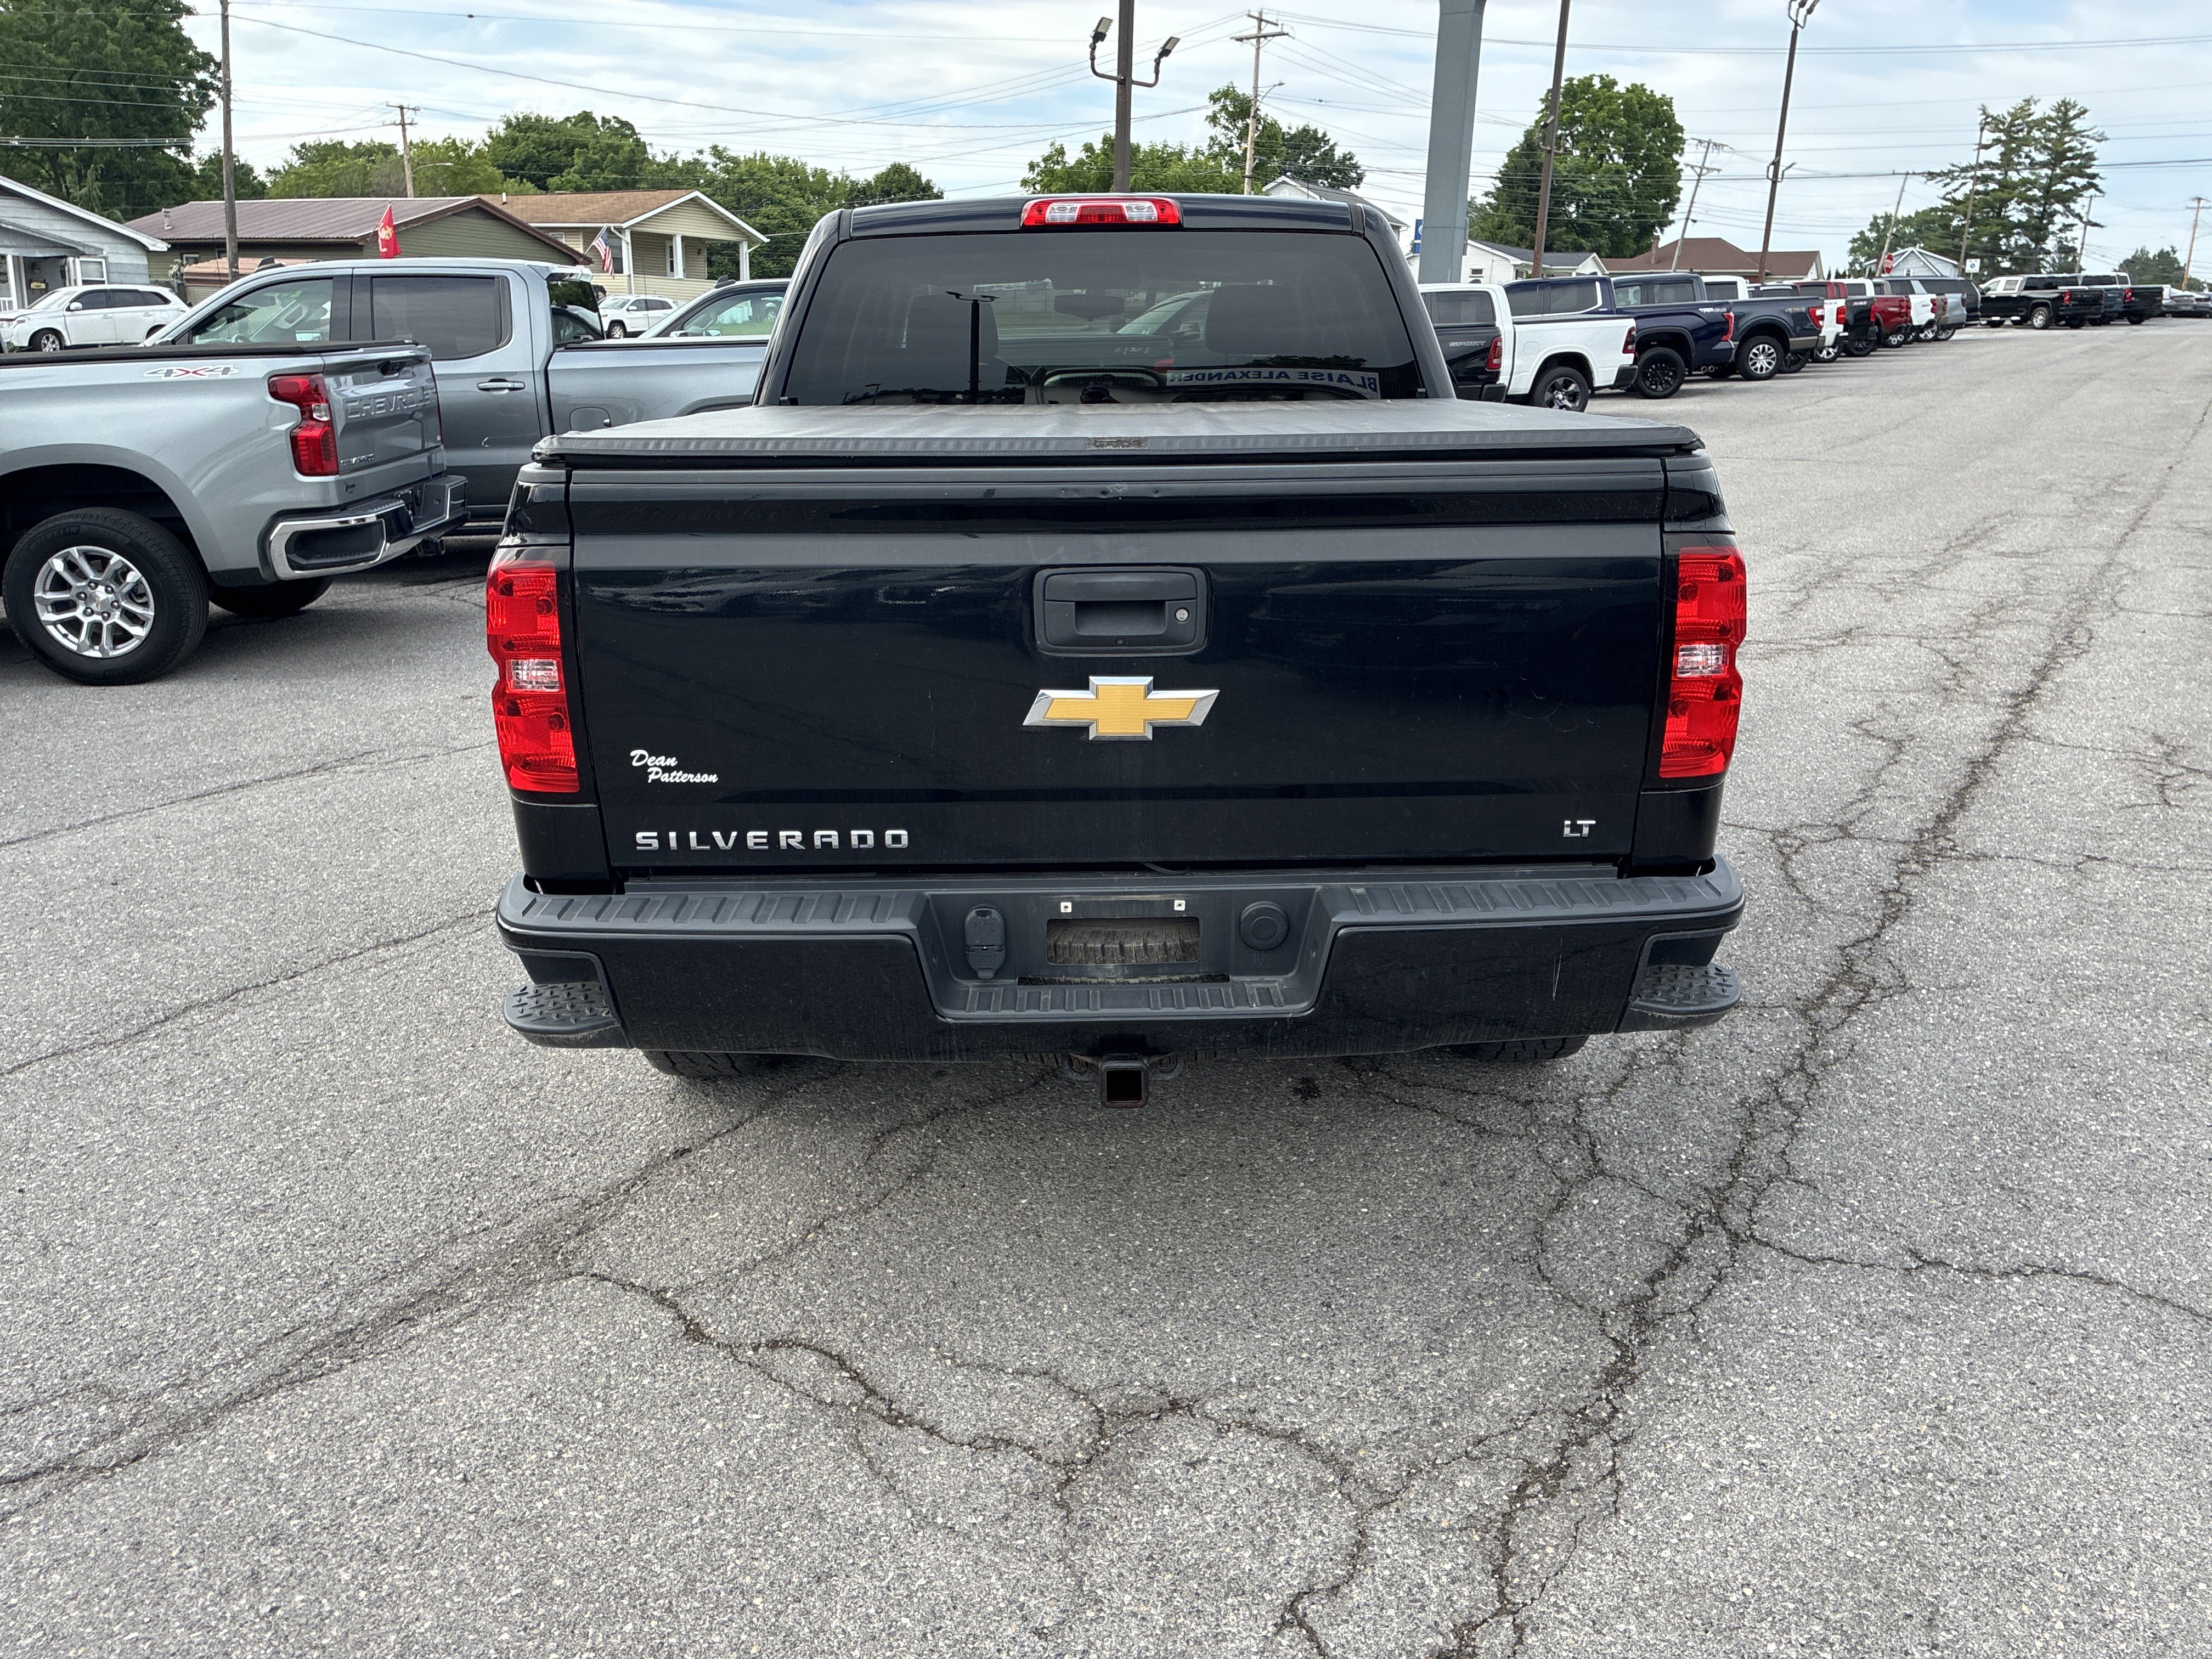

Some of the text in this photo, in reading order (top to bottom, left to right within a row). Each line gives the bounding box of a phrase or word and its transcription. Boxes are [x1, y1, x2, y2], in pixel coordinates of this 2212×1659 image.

[630, 749, 678, 766] Dean
[647, 767, 718, 783] Patterson
[636, 820, 1596, 851] SILVERADO LT
